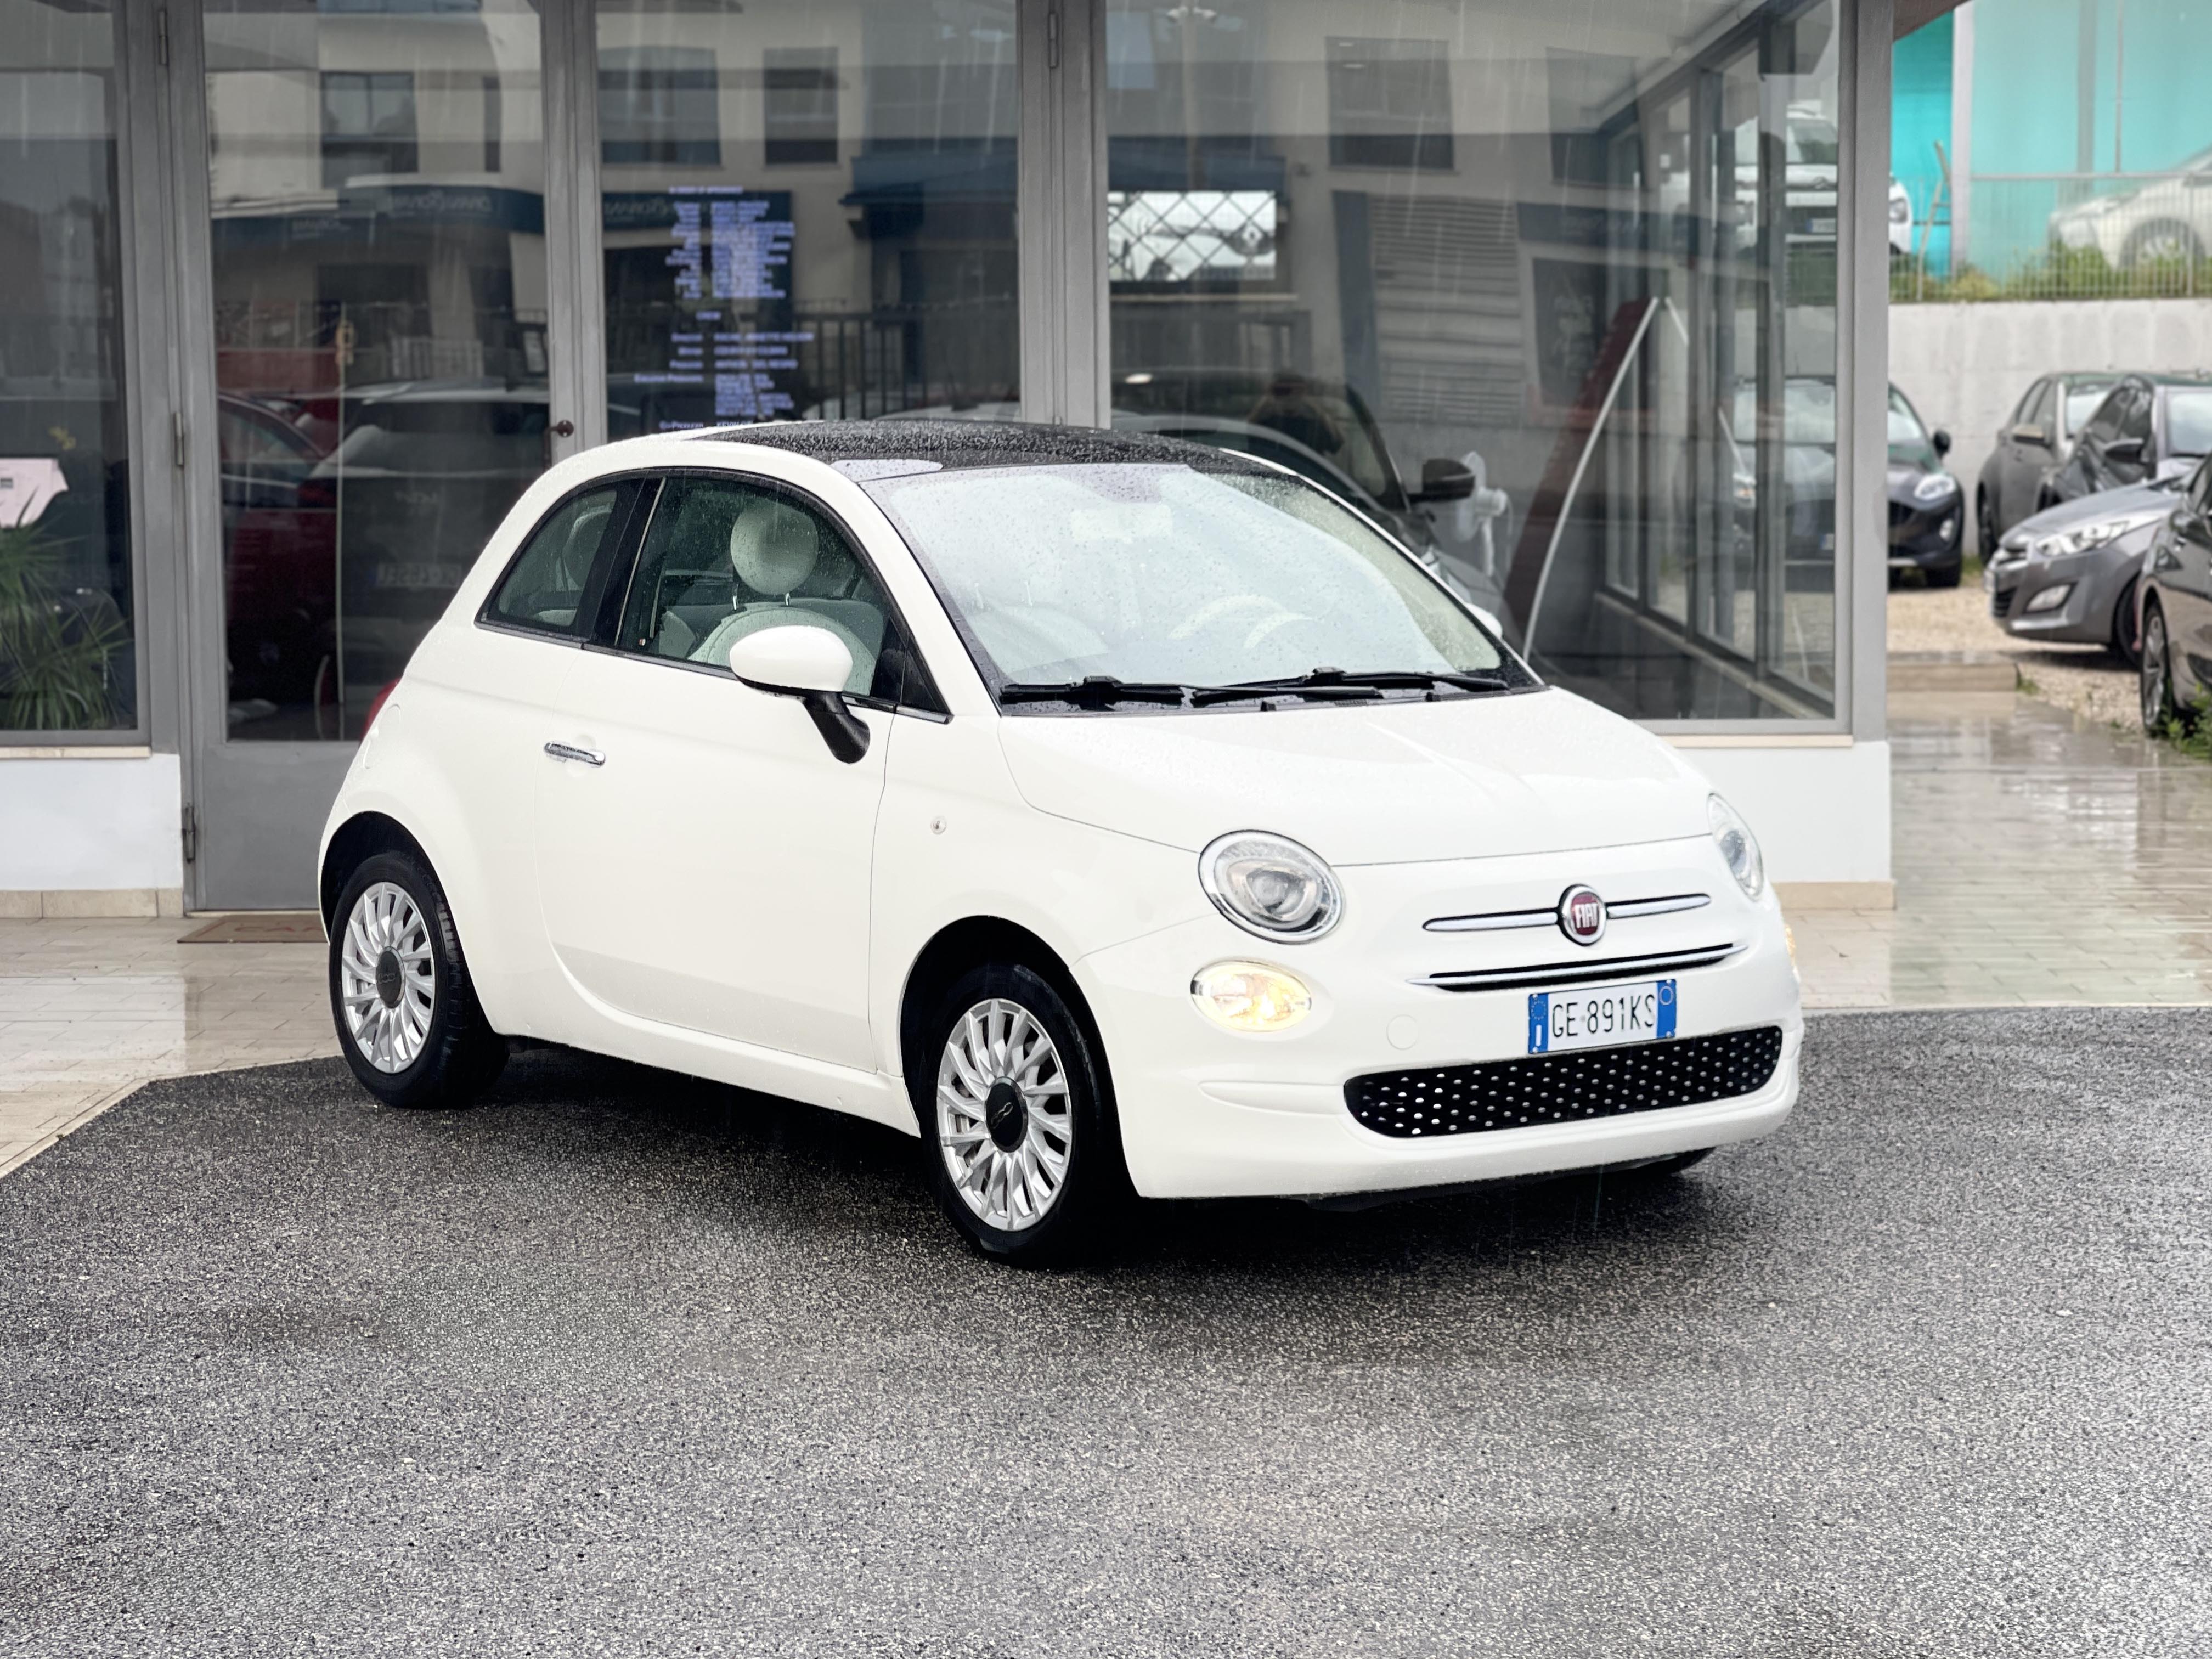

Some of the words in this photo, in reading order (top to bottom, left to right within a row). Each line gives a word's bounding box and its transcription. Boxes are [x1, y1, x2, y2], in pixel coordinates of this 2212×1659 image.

[1574, 902, 1598, 929] FIAT
[1553, 1002, 1579, 1038] GE
[1587, 993, 1655, 1034] 891KS
